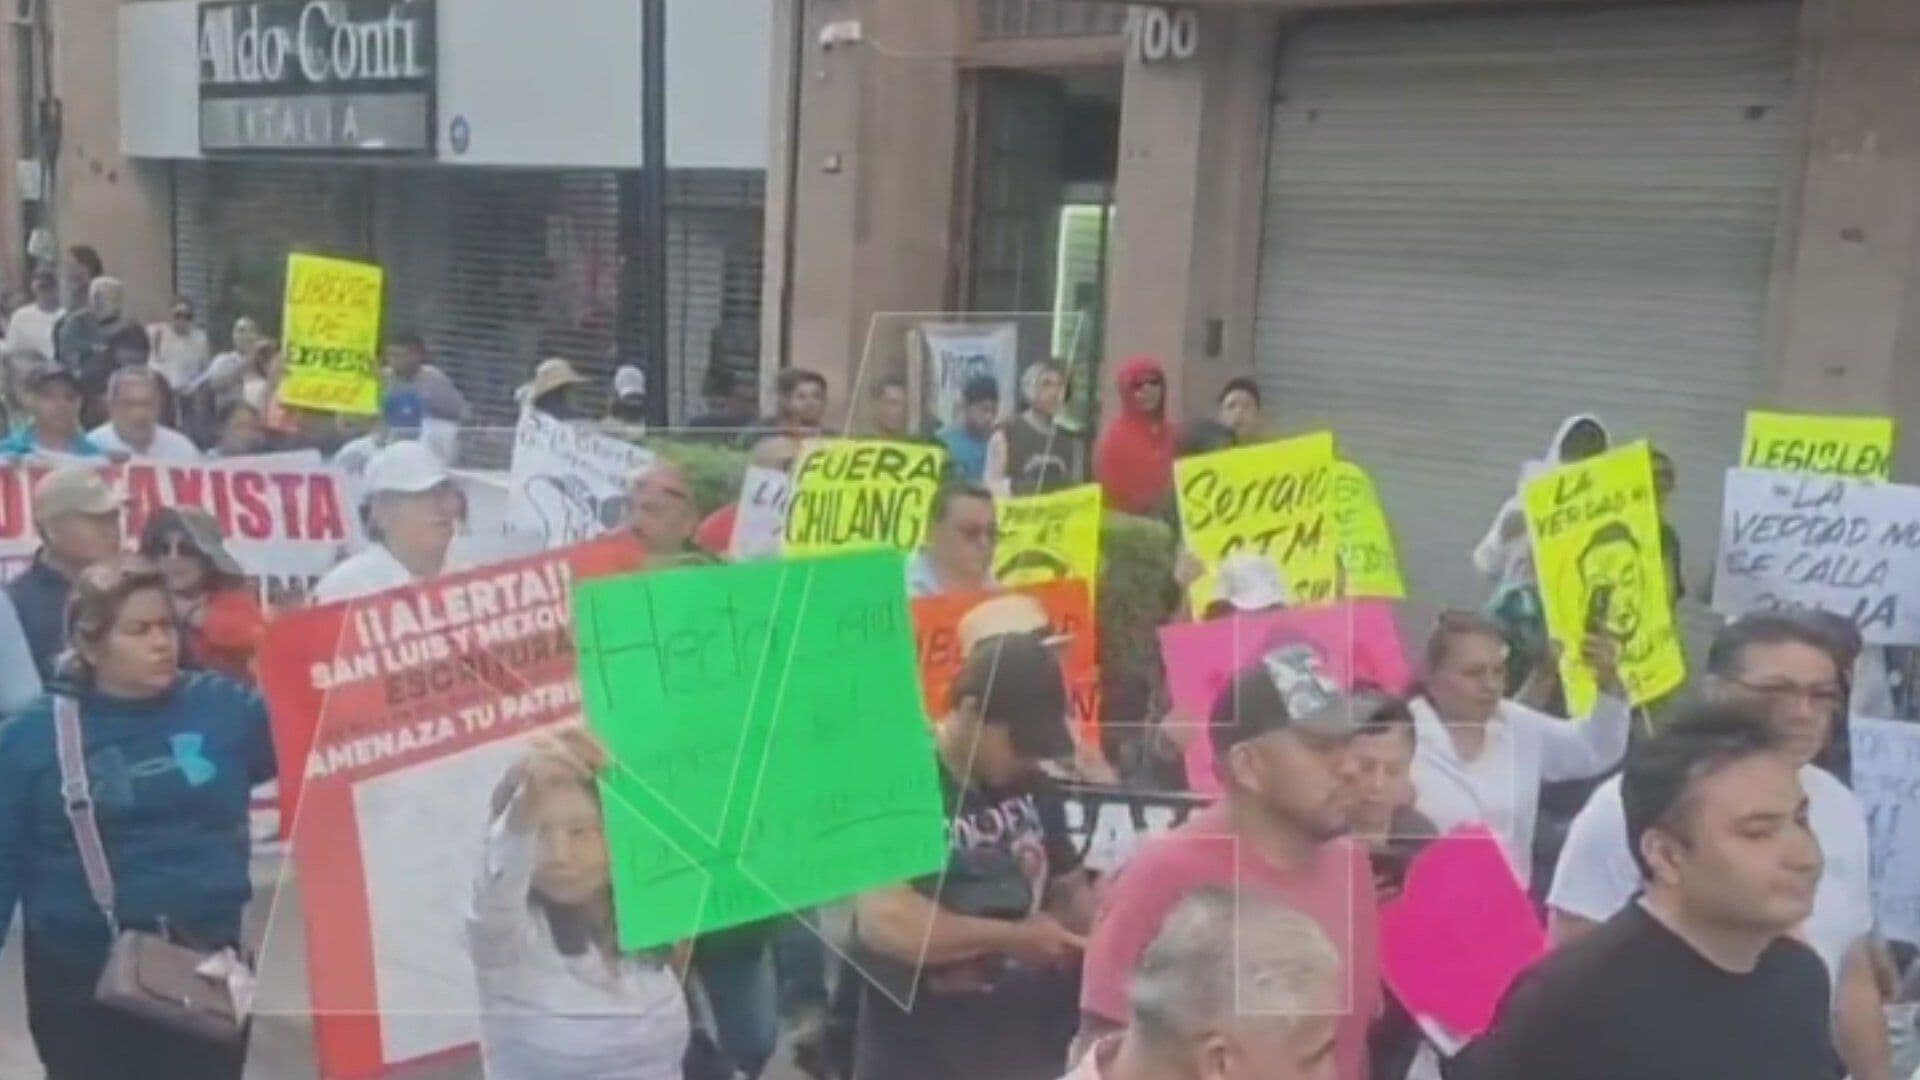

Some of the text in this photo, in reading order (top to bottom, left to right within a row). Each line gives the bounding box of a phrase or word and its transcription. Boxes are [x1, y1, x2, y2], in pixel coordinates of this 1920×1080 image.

[199, 1, 429, 82] Aldo Conti
[800, 447, 941, 482] FUERA
[1733, 511, 1868, 546] VERDAD
[1784, 552, 1889, 588] CALLA
[382, 634, 448, 673] LUIS
[302, 716, 457, 781] AMENAZA
[459, 702, 496, 737] TU
